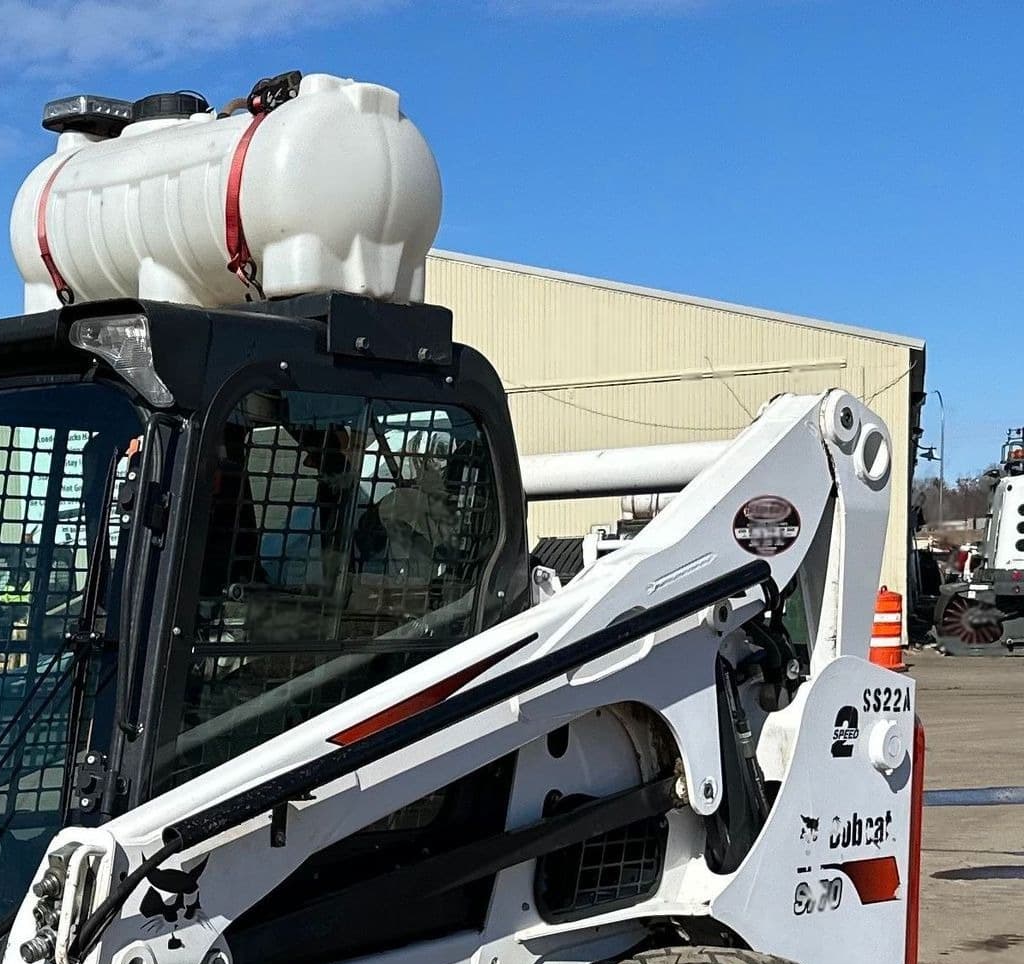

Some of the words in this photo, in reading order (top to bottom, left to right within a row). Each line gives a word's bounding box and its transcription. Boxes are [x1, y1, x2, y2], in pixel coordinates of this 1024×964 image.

[863, 687, 911, 712] SS22A
[831, 705, 859, 757] 2
[833, 729, 859, 740] SPEED
